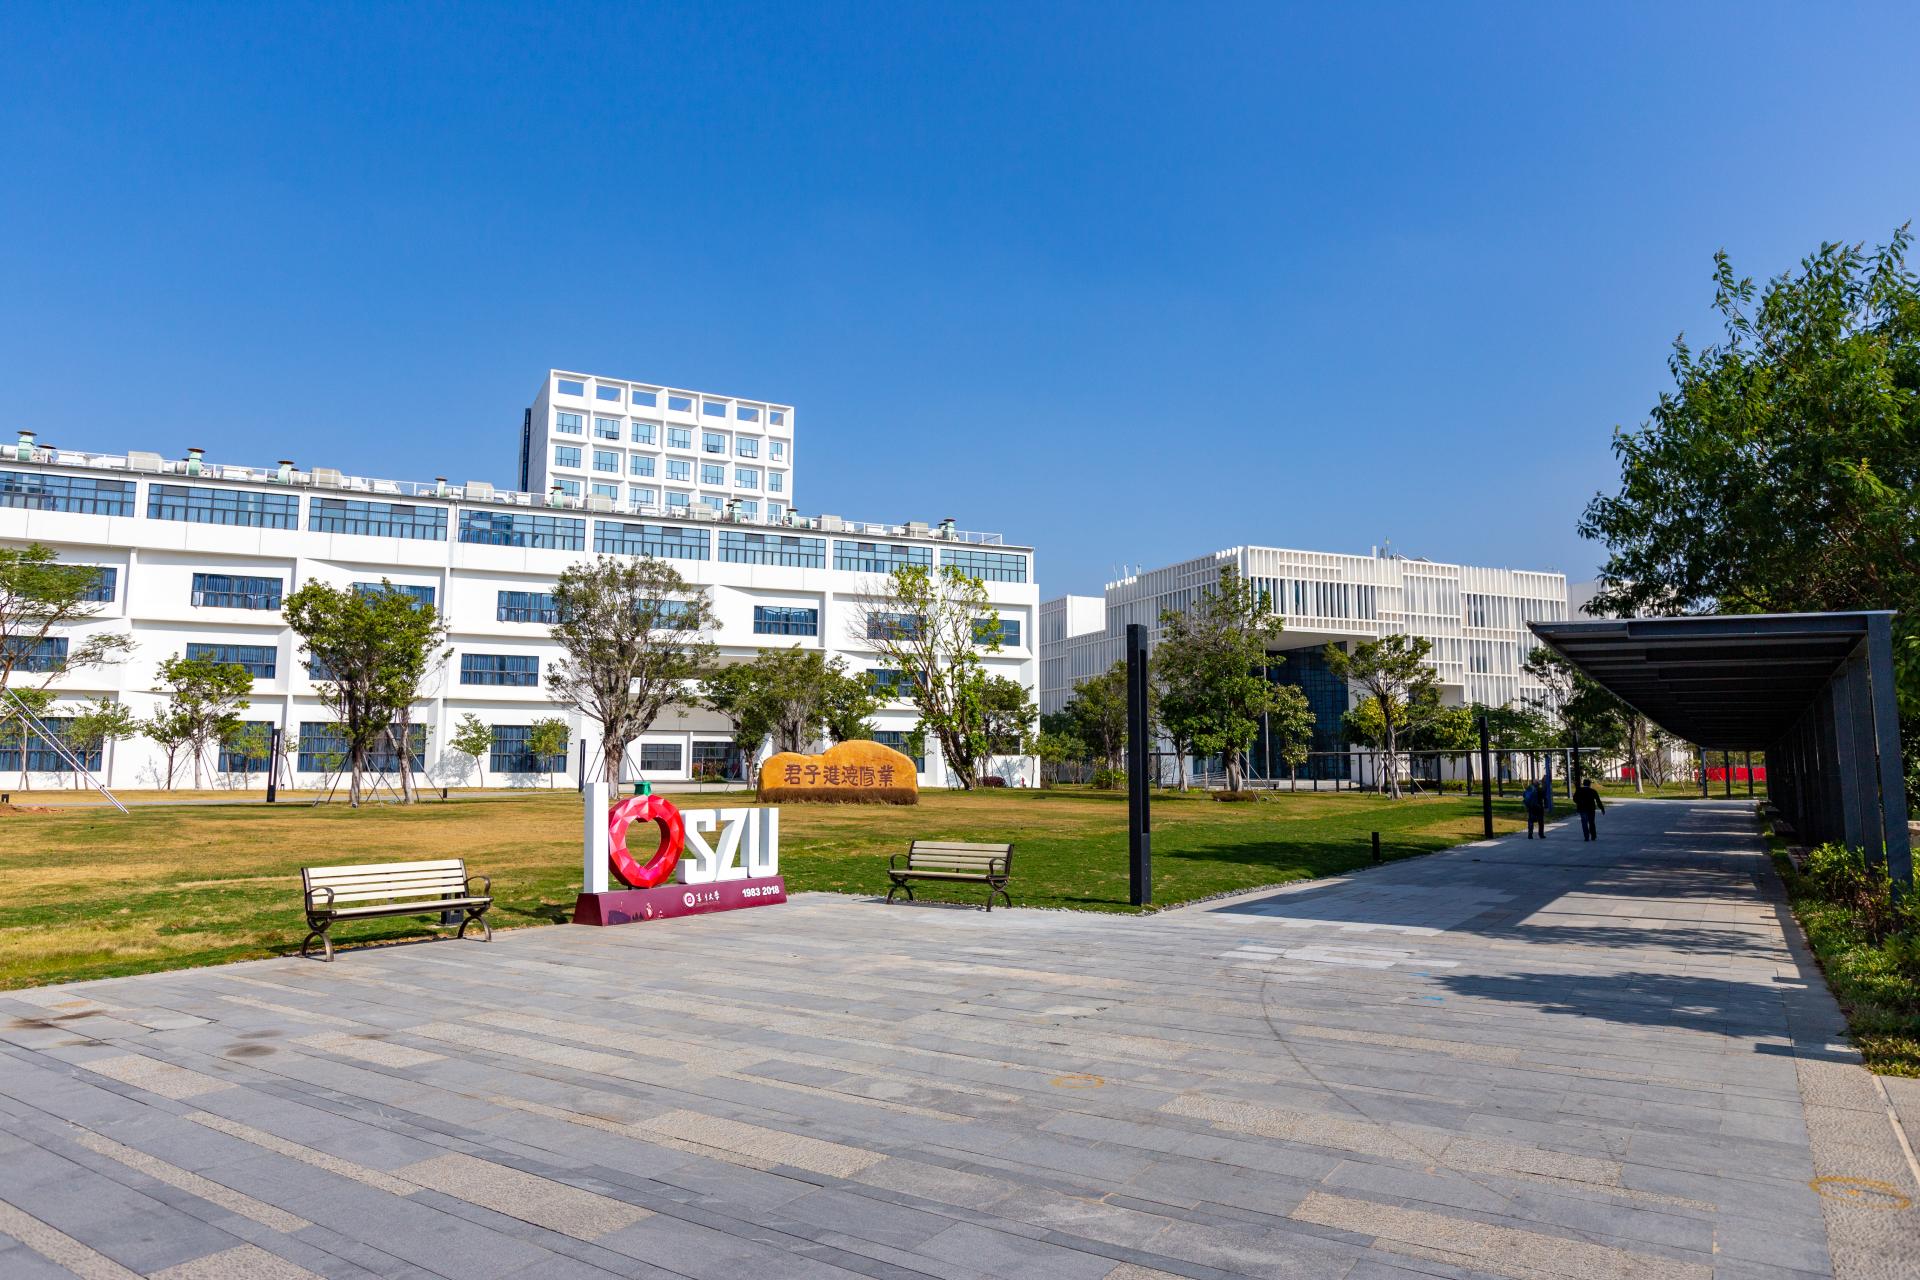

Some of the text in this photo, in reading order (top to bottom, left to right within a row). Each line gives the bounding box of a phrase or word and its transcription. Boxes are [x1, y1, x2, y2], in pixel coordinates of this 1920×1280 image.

[584, 782, 779, 893] I SZU
[742, 885, 780, 898] 1983 2018
